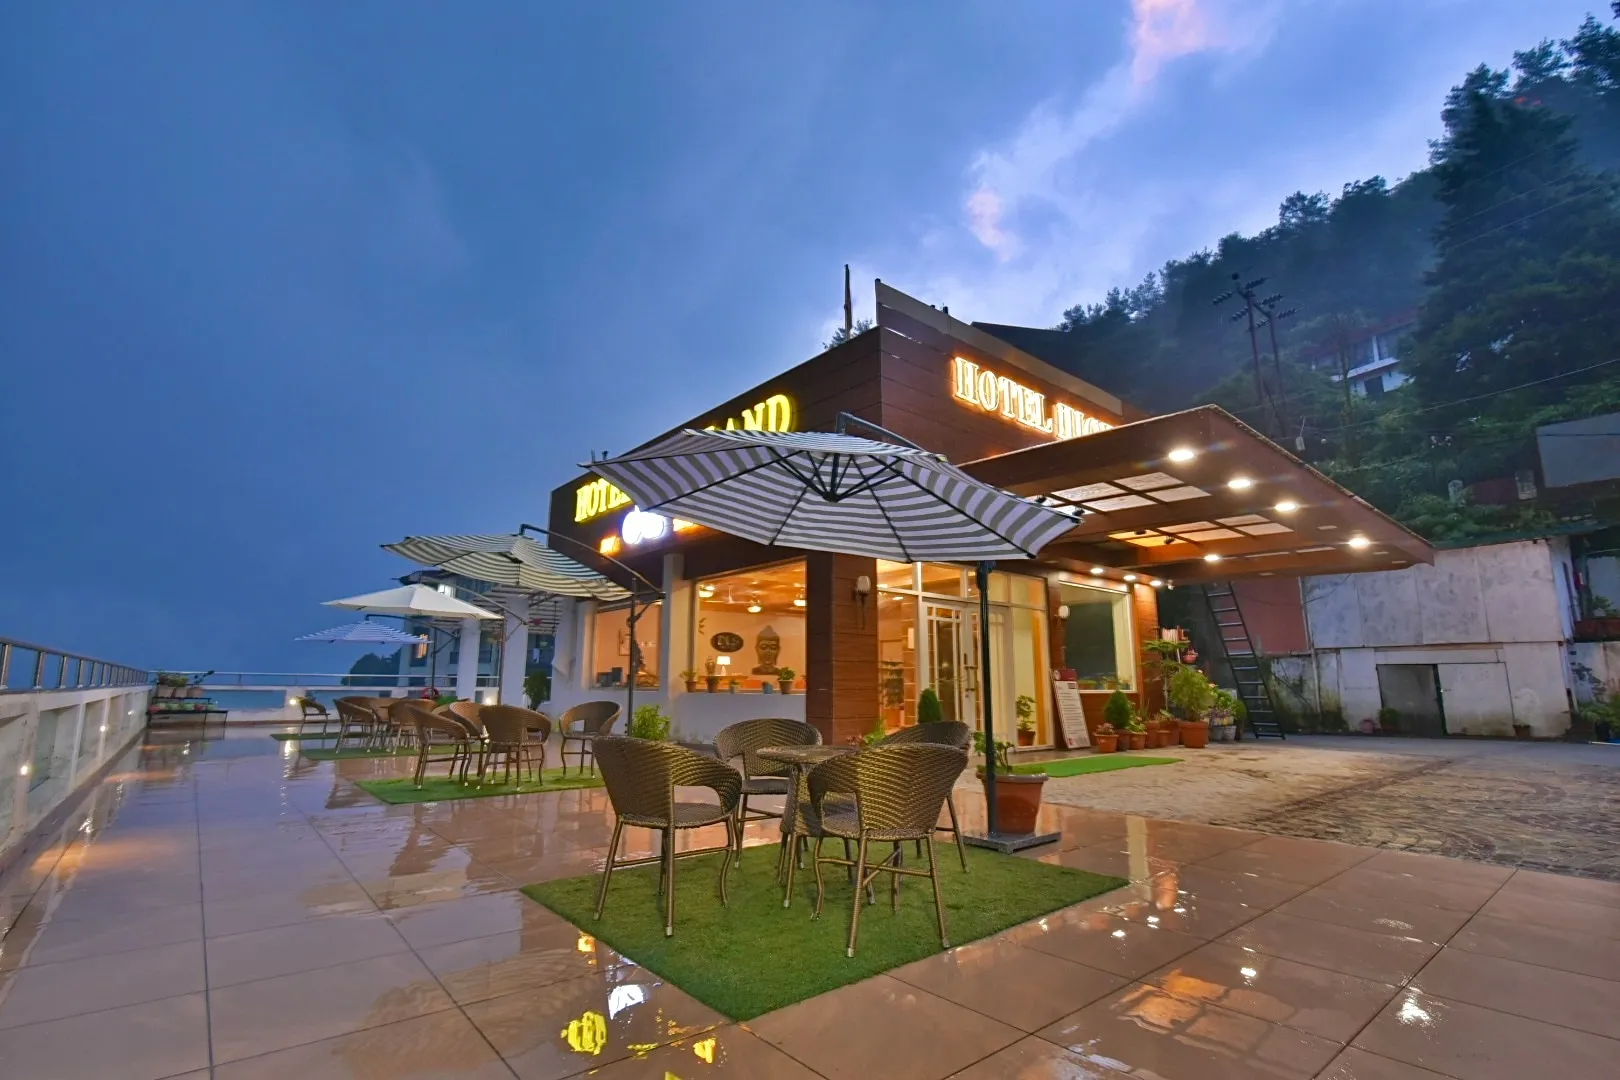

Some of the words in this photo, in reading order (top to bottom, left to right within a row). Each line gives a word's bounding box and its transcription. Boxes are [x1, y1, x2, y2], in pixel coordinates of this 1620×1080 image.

[703, 394, 790, 432] ND
[954, 356, 1053, 433] HOTEL
[1056, 402, 1113, 440] HI
